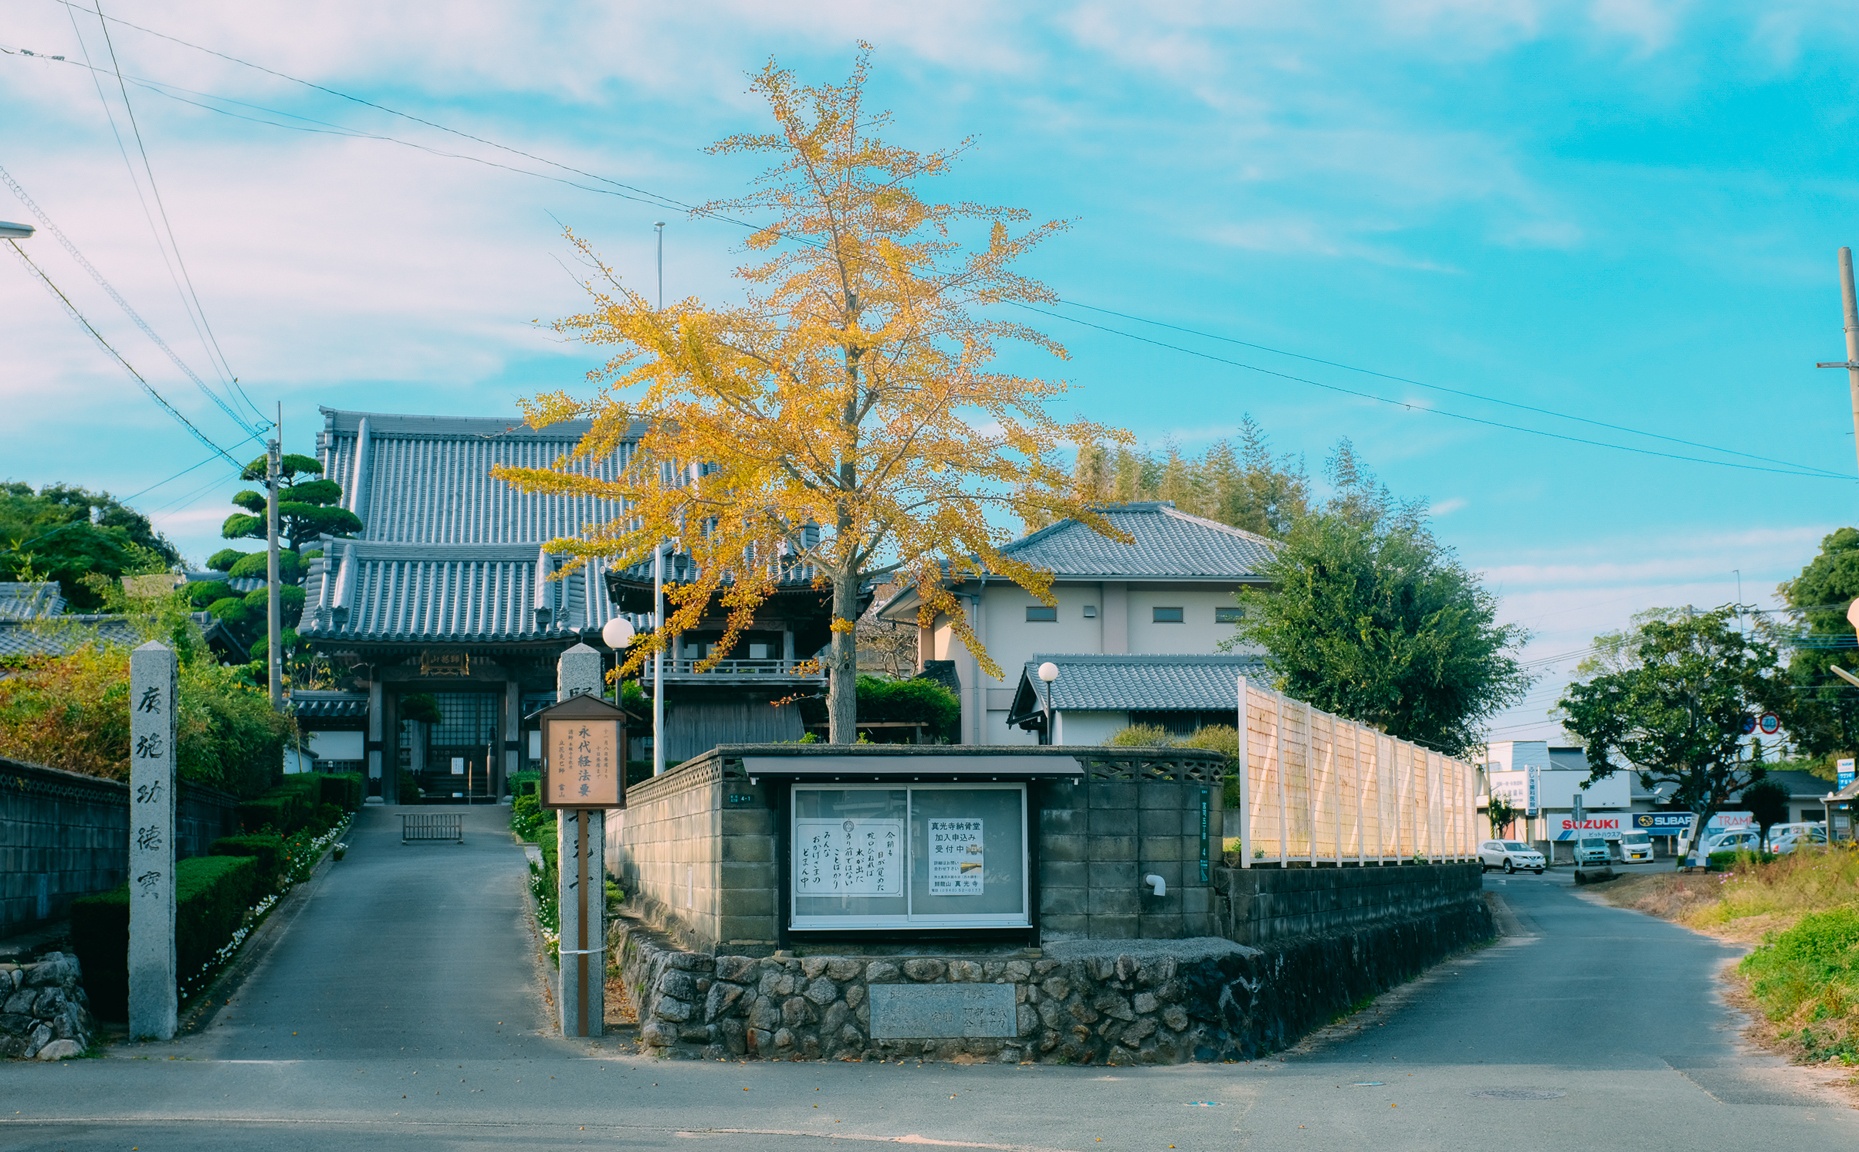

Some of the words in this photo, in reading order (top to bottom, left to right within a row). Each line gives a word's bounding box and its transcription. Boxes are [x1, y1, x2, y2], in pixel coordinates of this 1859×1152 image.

[578, 725, 592, 797] 永代経法要
[931, 822, 981, 831] 真光寺納骨堂
[1561, 820, 1619, 830] SUZUKI
[823, 831, 831, 858] みんな
[935, 833, 976, 842] 加入申込み
[935, 844, 964, 853] 受付中
[800, 848, 810, 889] どまん中
[833, 848, 841, 890] ことばかり
